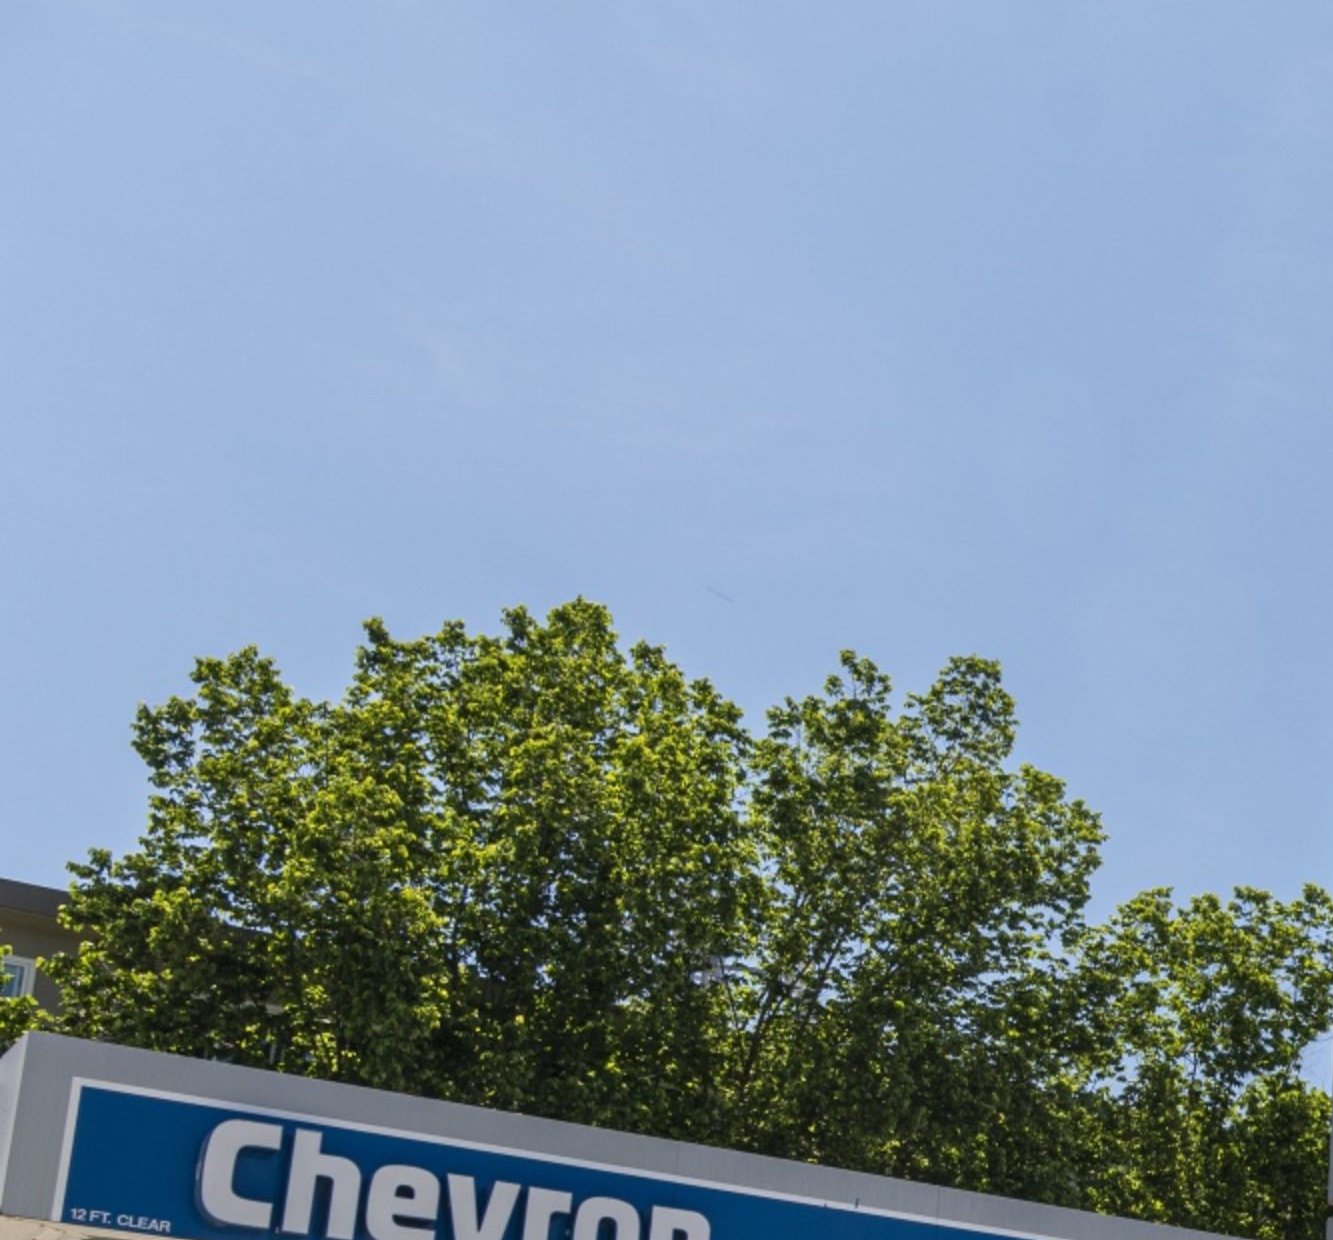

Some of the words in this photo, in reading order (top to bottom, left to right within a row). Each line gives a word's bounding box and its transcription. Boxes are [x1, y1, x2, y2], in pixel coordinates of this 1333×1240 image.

[70, 1207, 87, 1222] 12
[89, 1209, 112, 1225] FT.
[116, 1213, 173, 1234] CLEAR
